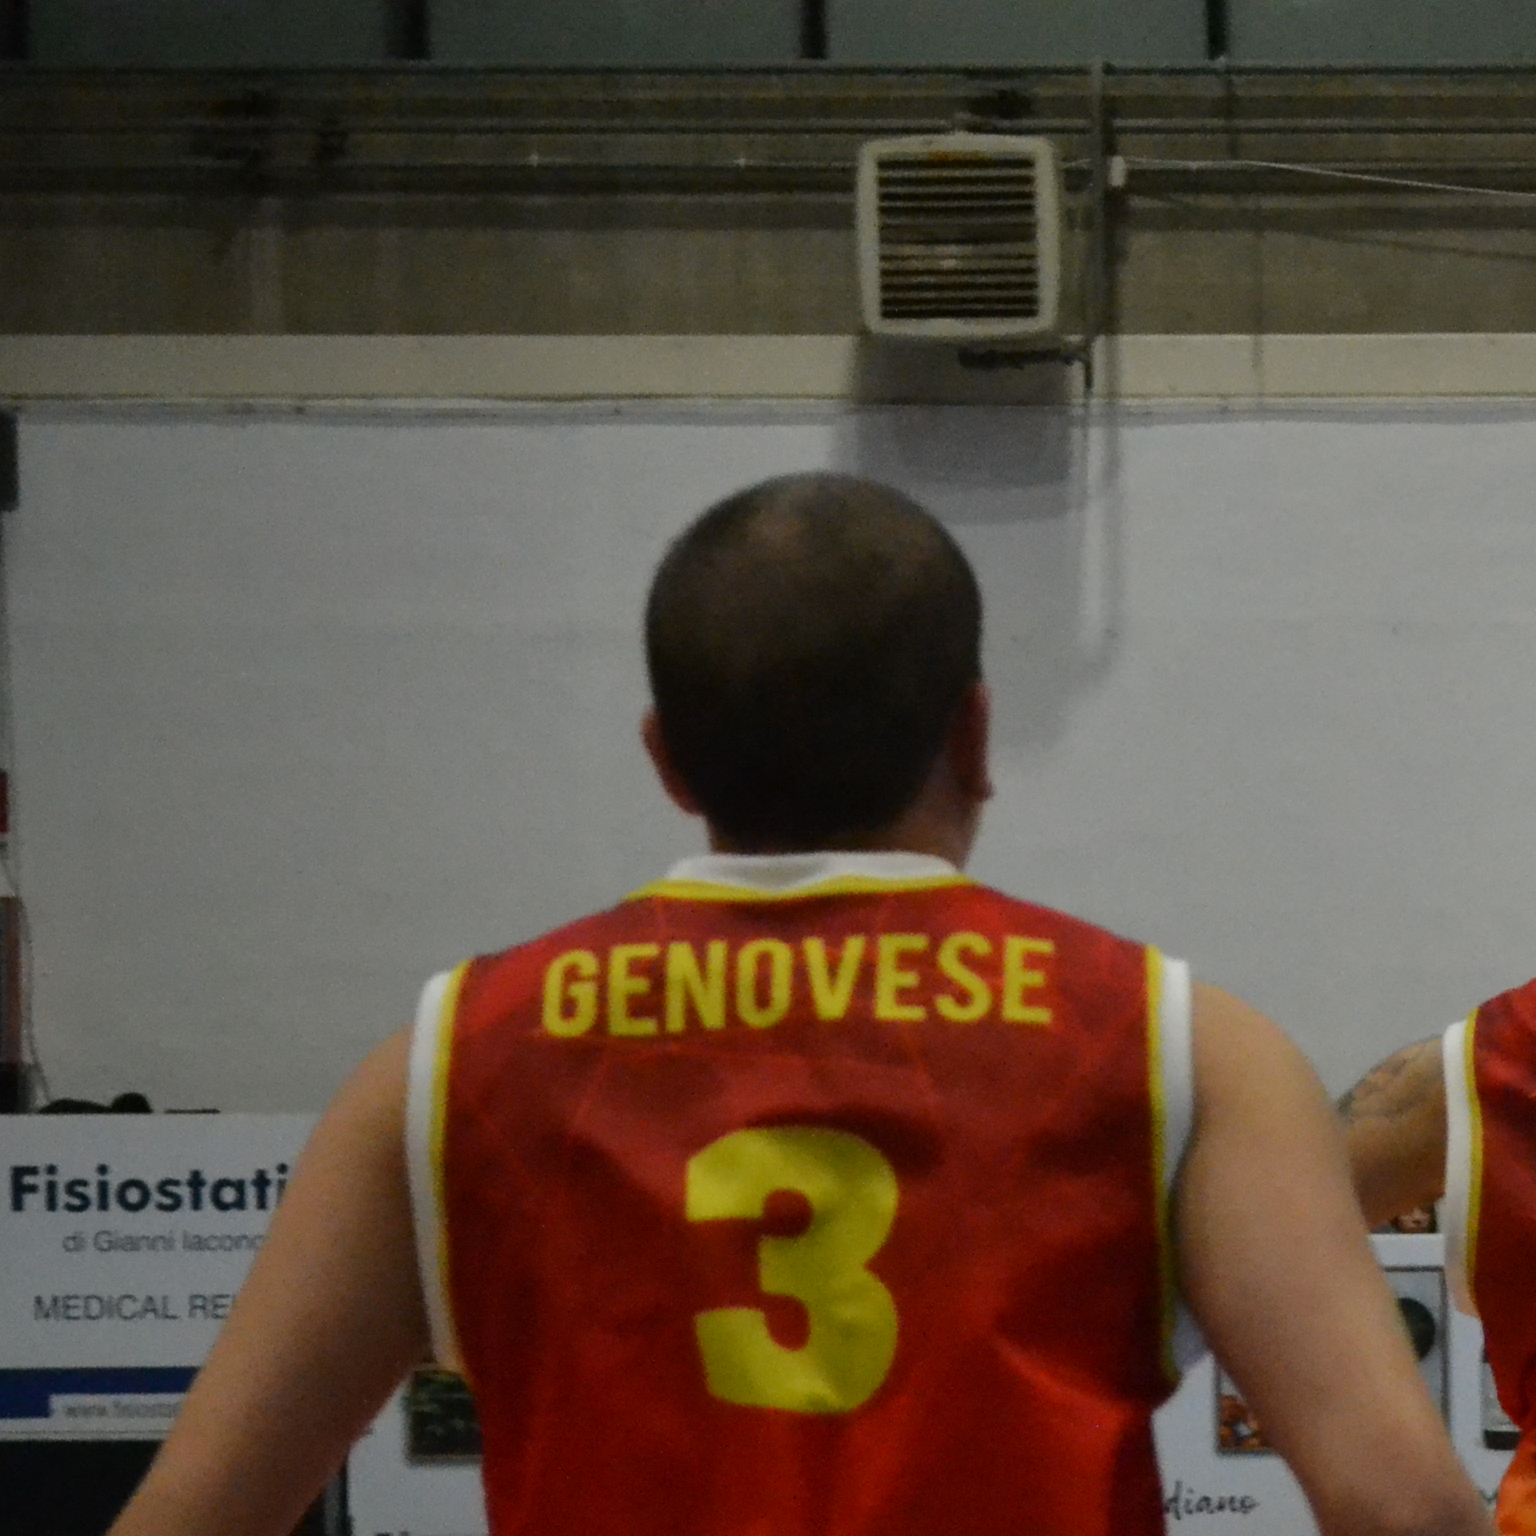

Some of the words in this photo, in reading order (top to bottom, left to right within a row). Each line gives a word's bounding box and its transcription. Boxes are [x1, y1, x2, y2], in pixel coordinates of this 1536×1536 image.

[540, 930, 1057, 1039] GENOVESE
[33, 1294, 181, 1322] MEDICAL
[187, 1294, 237, 1321] RE
[685, 1125, 900, 1415] 3
